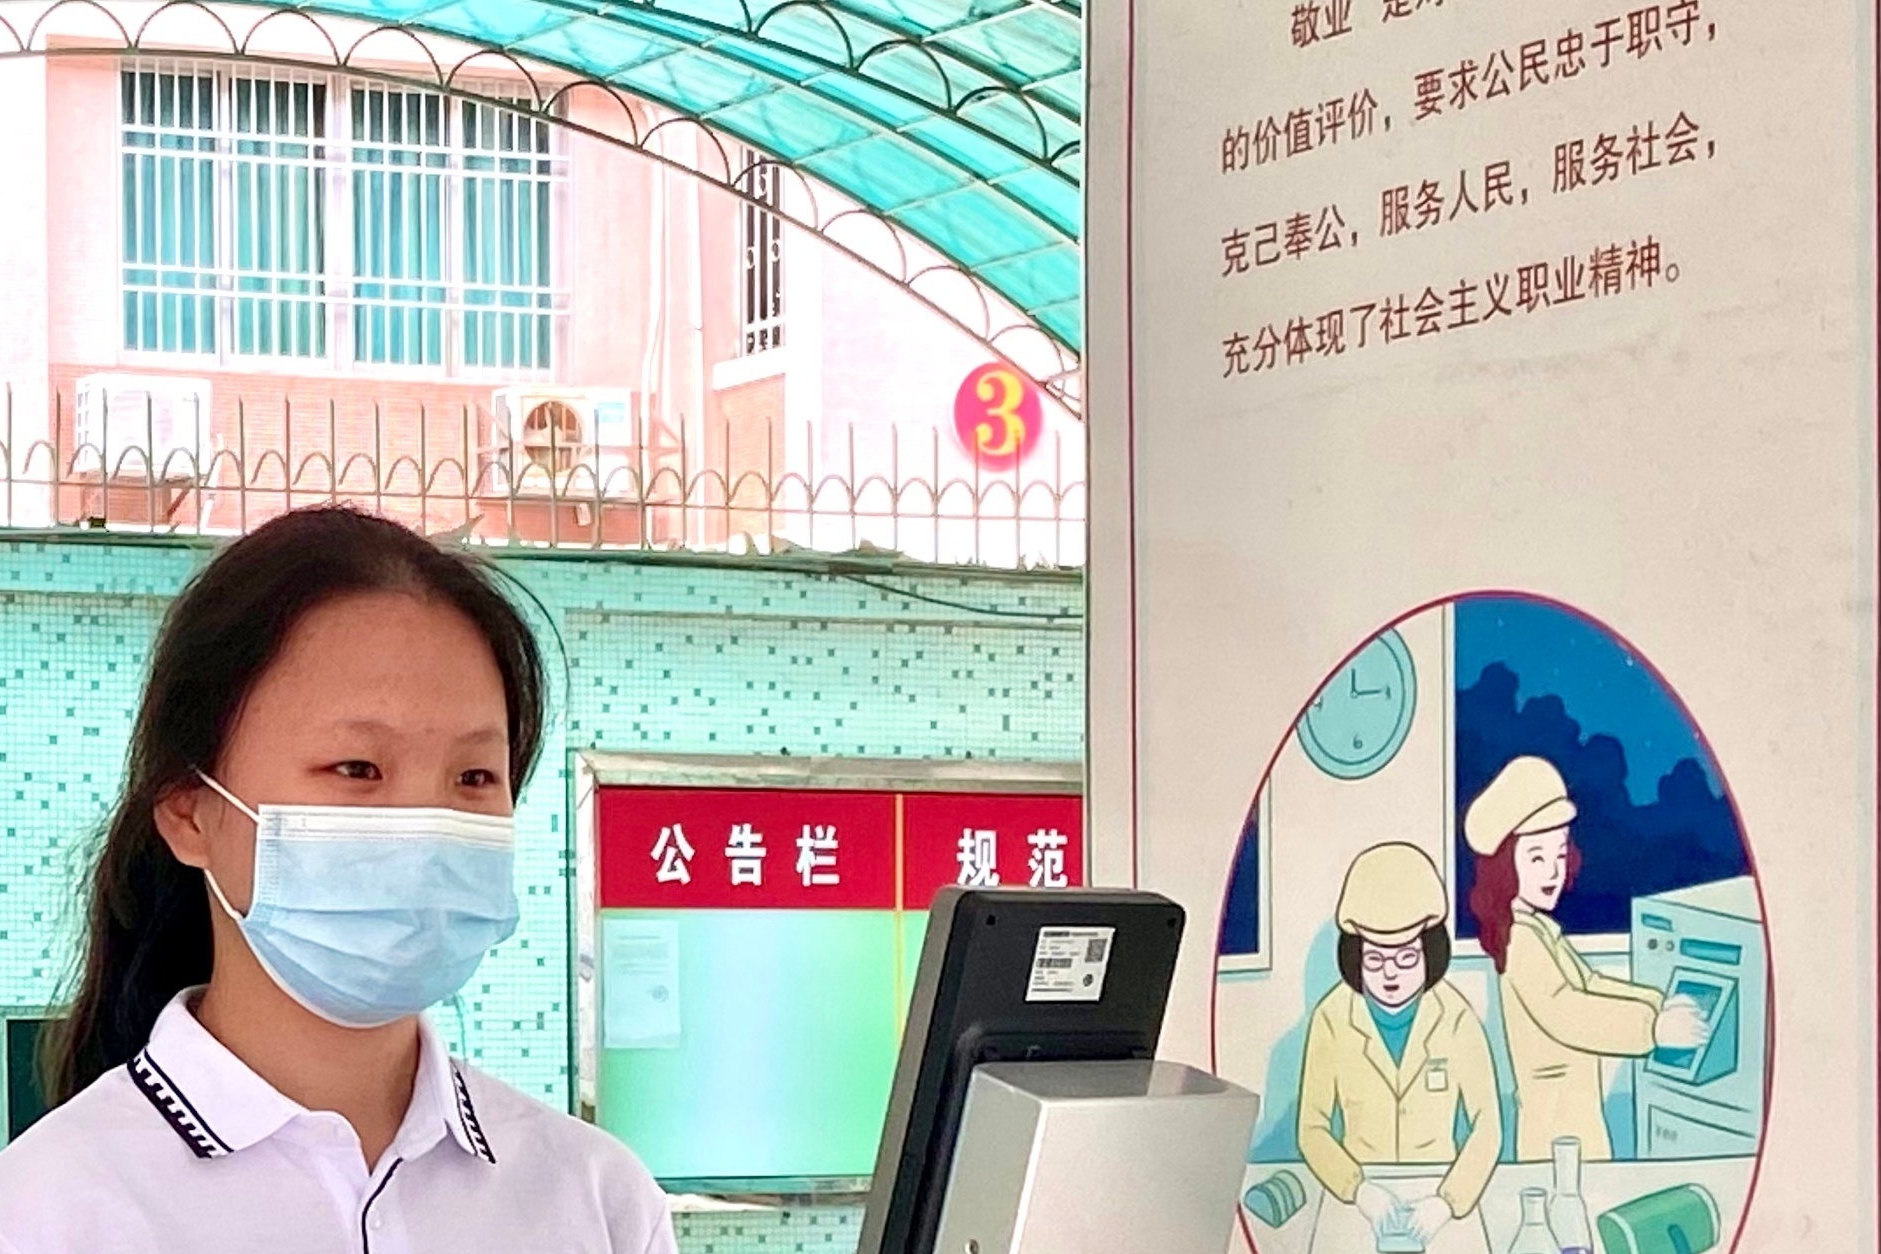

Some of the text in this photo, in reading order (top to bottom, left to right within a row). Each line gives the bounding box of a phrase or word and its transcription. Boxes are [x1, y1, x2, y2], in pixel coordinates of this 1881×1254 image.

[1221, 111, 1717, 276] 克己奉公，服务人民，服务社会，
[1221, 235, 1681, 378] 充分体现了社会主义职业精神。
[976, 370, 1026, 456] 3
[650, 824, 840, 886] 公告栏
[956, 828, 1068, 888] 规范
